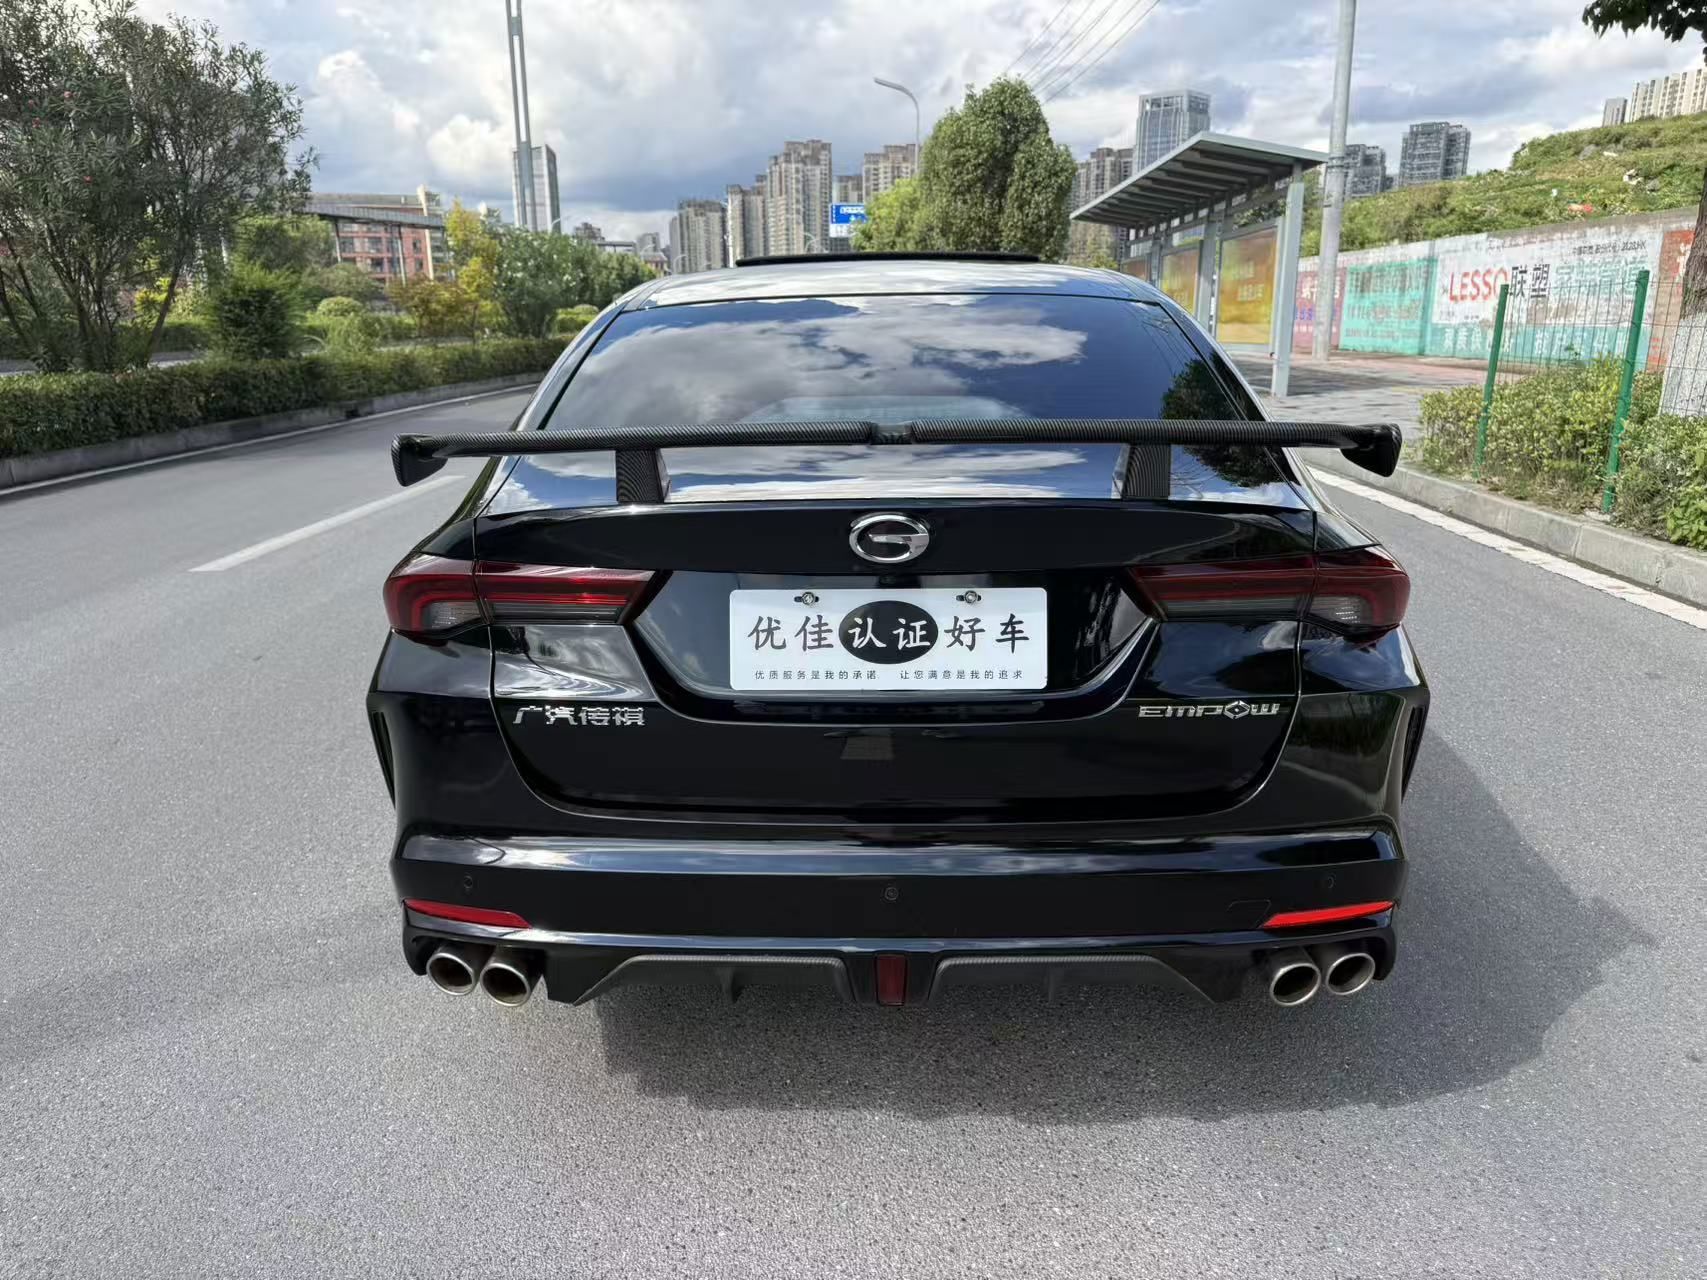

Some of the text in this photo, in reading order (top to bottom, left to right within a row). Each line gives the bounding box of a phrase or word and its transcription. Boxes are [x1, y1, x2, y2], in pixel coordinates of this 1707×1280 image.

[1449, 266, 1508, 303] LESSO
[1509, 263, 1551, 299] 联塑
[748, 613, 1030, 654] 优佳认证好车
[754, 669, 1024, 681] 优质服务是我的承诺 让您满意是我的追求
[512, 704, 646, 726] 广汽传祺
[1138, 700, 1281, 720] EMPOW
